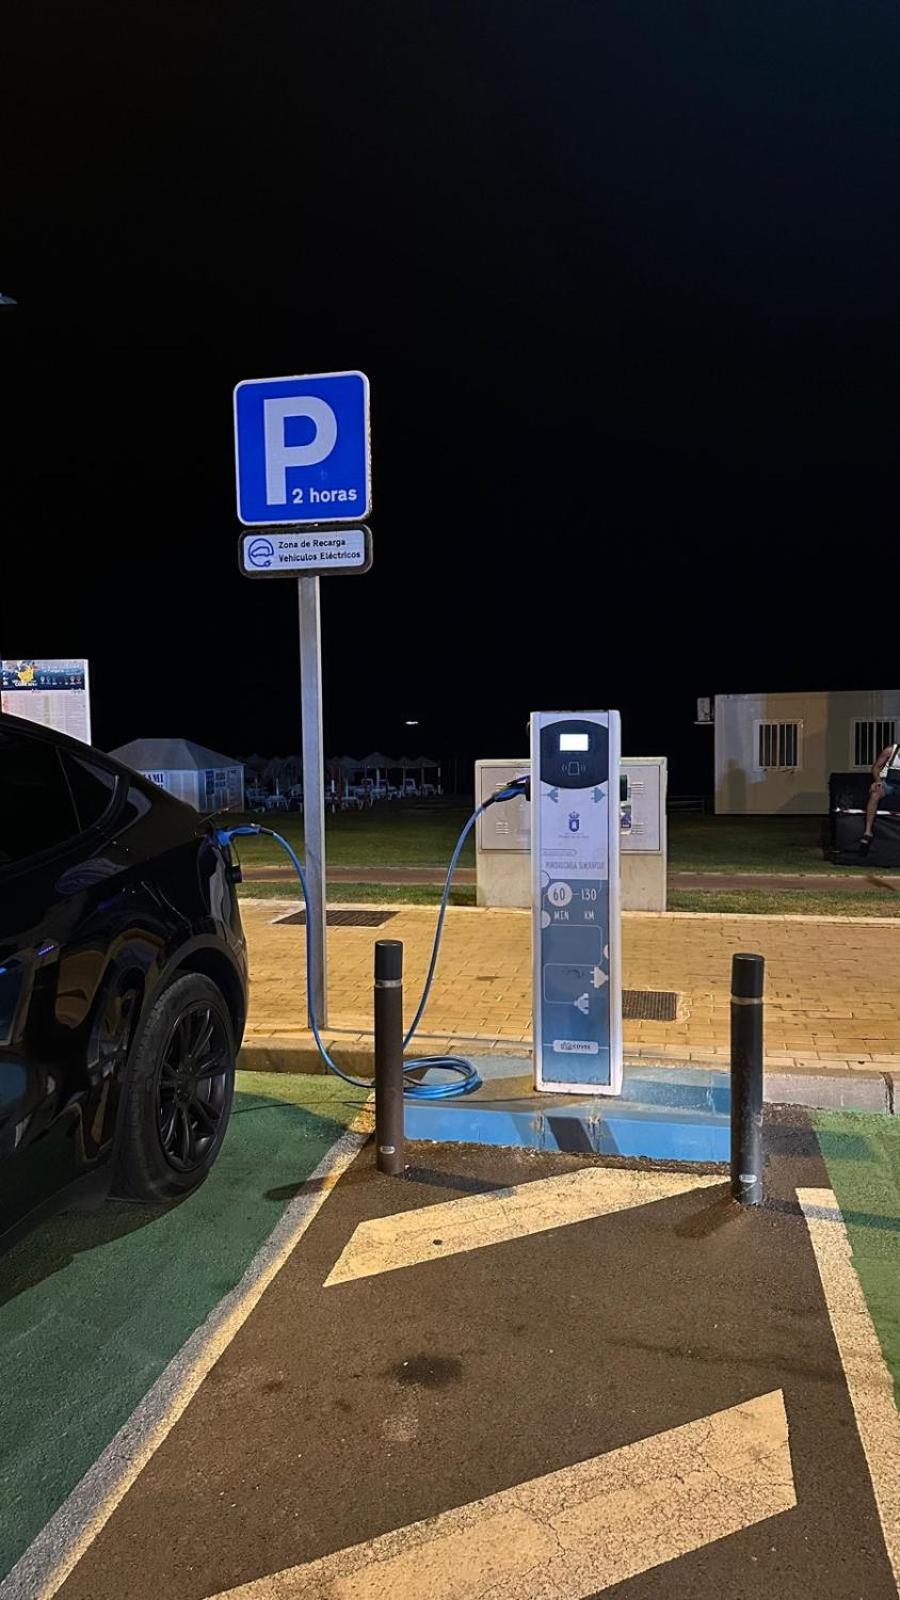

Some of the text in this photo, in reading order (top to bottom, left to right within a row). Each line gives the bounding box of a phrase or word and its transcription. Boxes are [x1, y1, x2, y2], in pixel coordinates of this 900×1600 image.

[263, 395, 338, 505] P
[292, 487, 357, 504] 2 horas
[278, 539, 346, 549] Zona de Recarga
[320, 551, 361, 560] Eléctricos
[553, 887, 597, 901] 60 130
[554, 910, 595, 920] MIN KM
